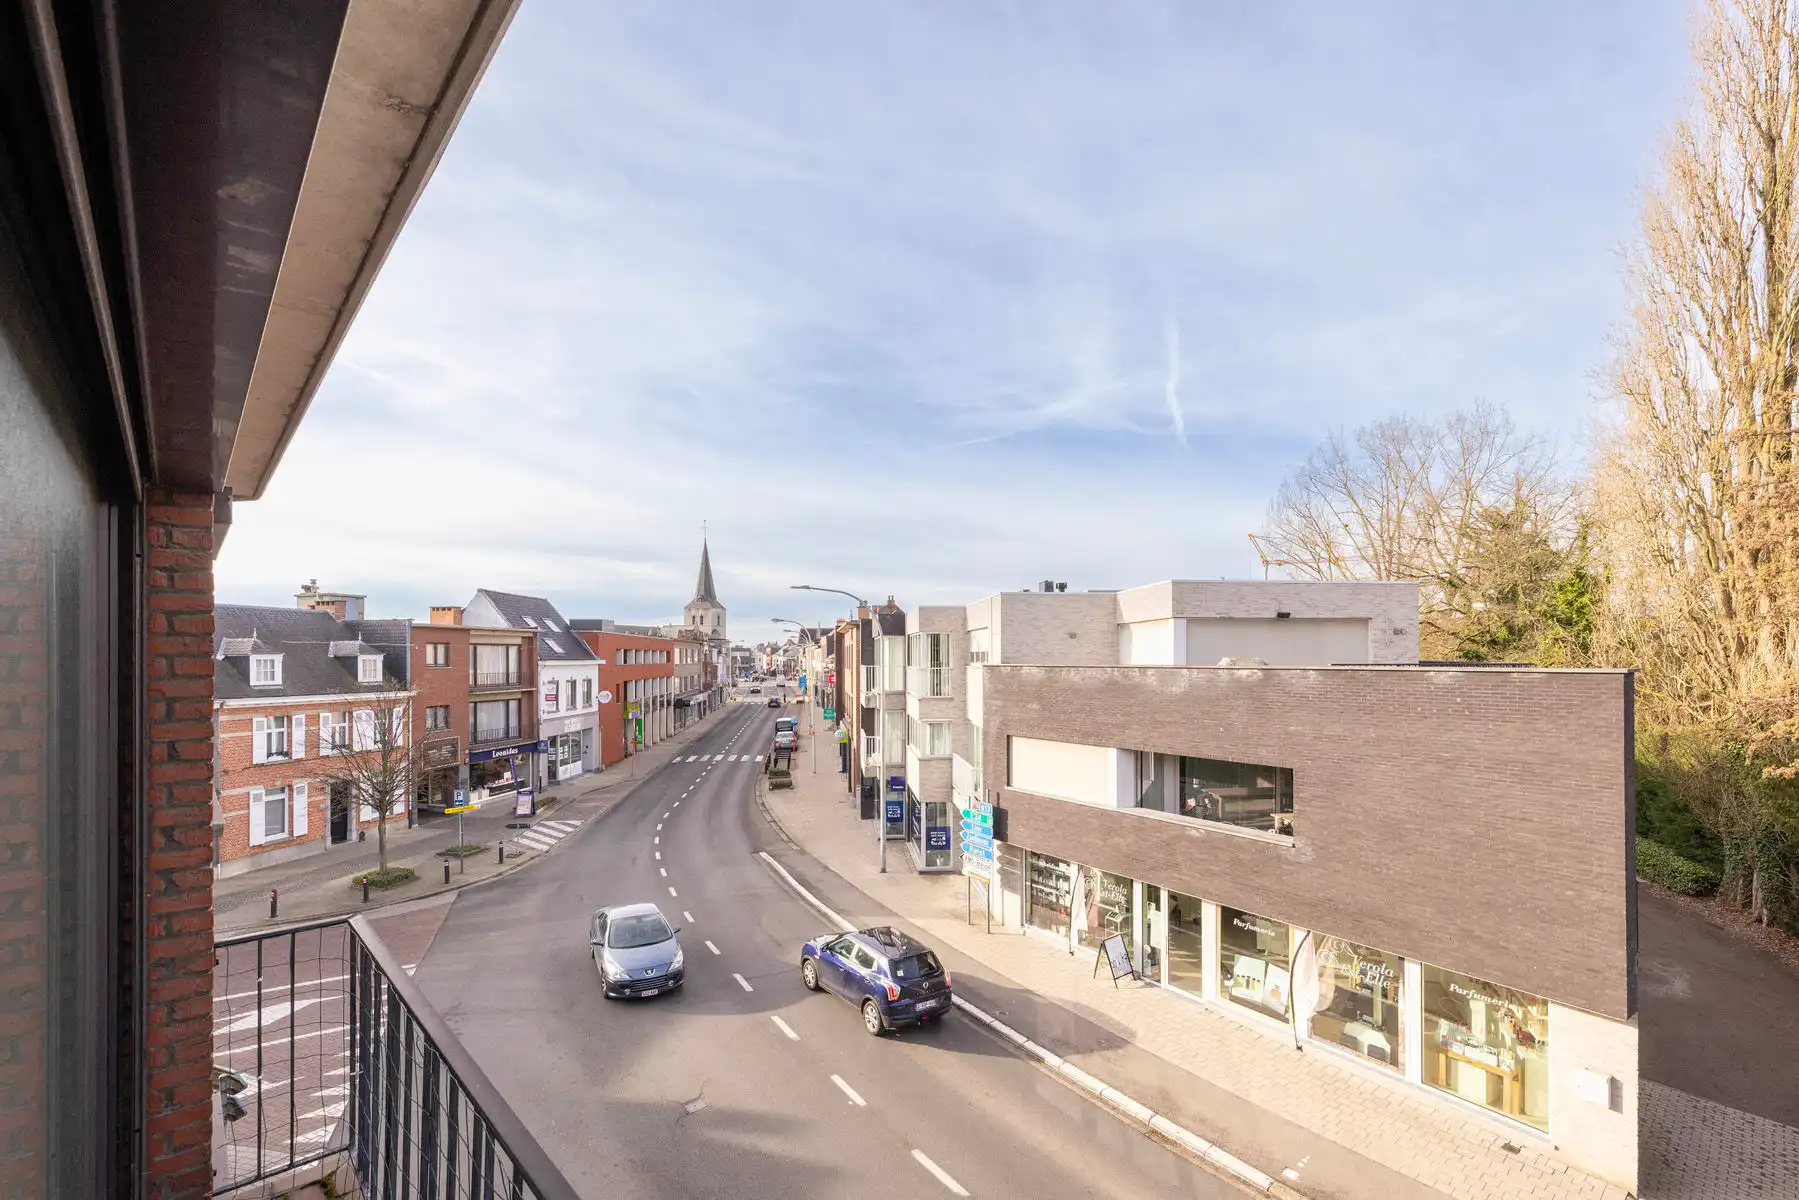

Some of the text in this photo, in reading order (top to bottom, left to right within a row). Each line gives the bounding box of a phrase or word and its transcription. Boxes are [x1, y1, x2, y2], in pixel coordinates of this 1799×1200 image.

[492, 748, 518, 758] Leonidas
[1233, 918, 1276, 937] Parfumerie
[1341, 964, 1391, 989] Est-Elle
[1353, 955, 1394, 978] Verola
[1449, 983, 1518, 1009] Parfumerie
